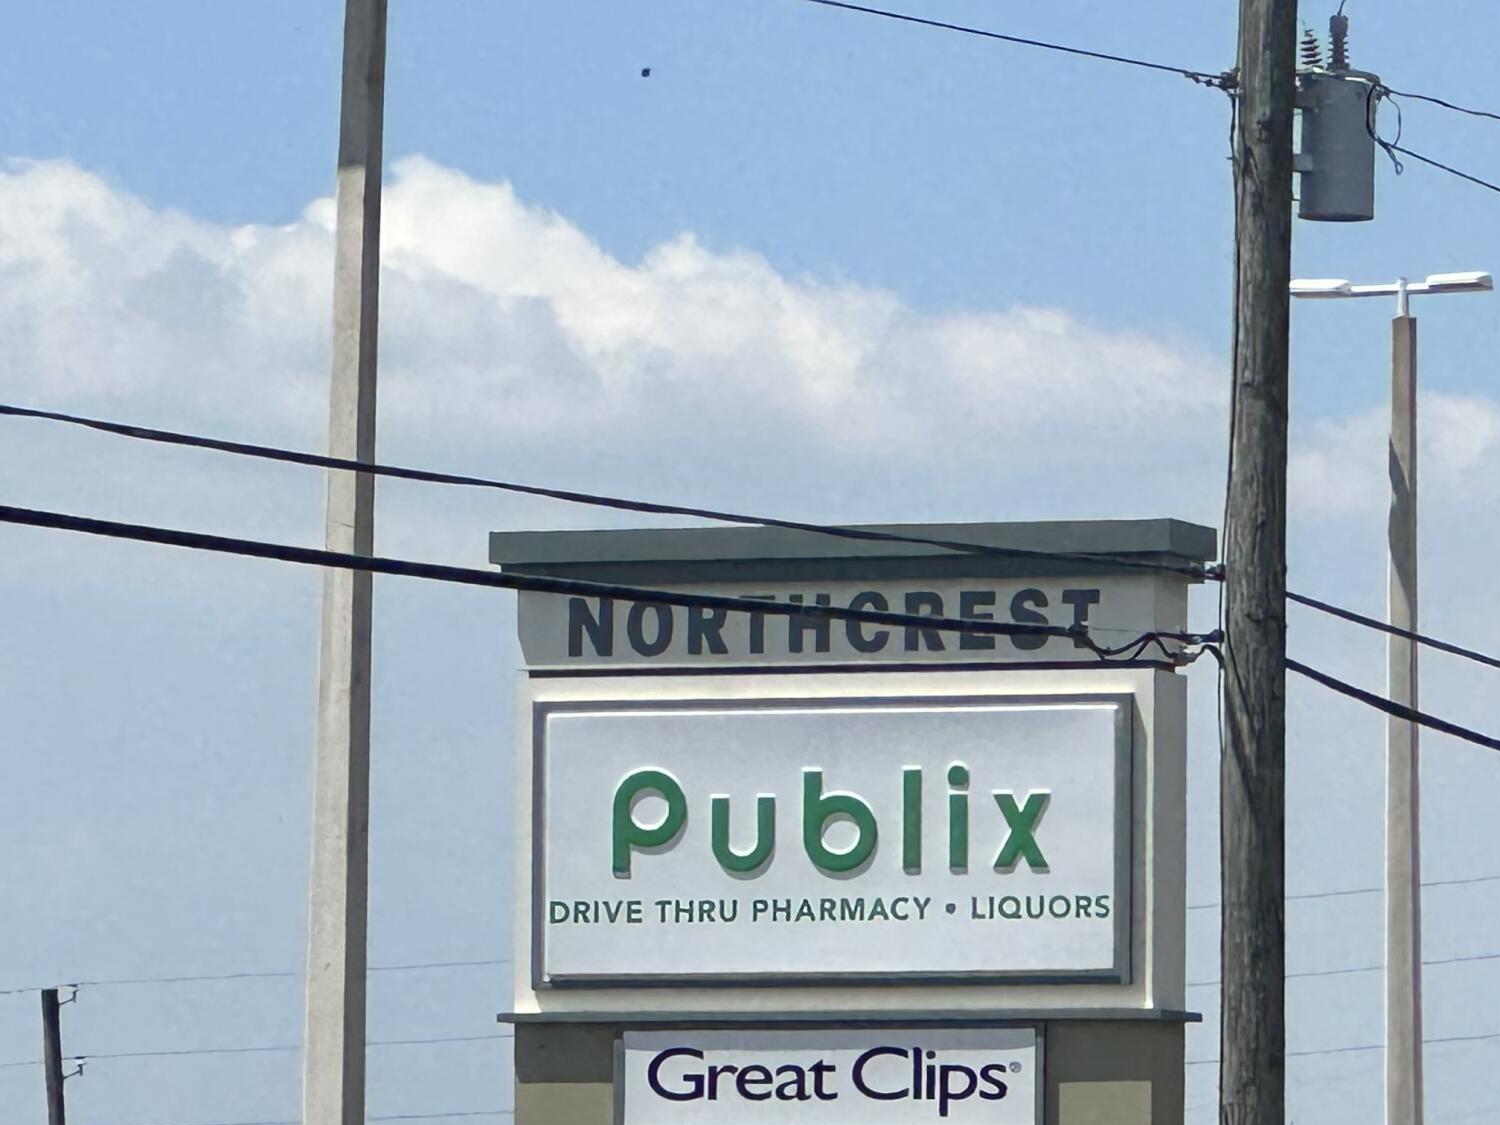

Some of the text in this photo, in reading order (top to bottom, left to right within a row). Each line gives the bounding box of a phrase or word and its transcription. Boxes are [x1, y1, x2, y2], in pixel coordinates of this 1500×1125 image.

[568, 588, 1100, 657] NORTHCREST
[612, 761, 1052, 879] Publix
[549, 894, 1110, 924] DRIVE THRU PHARMACY LIQUORS
[647, 1046, 838, 1102] Great
